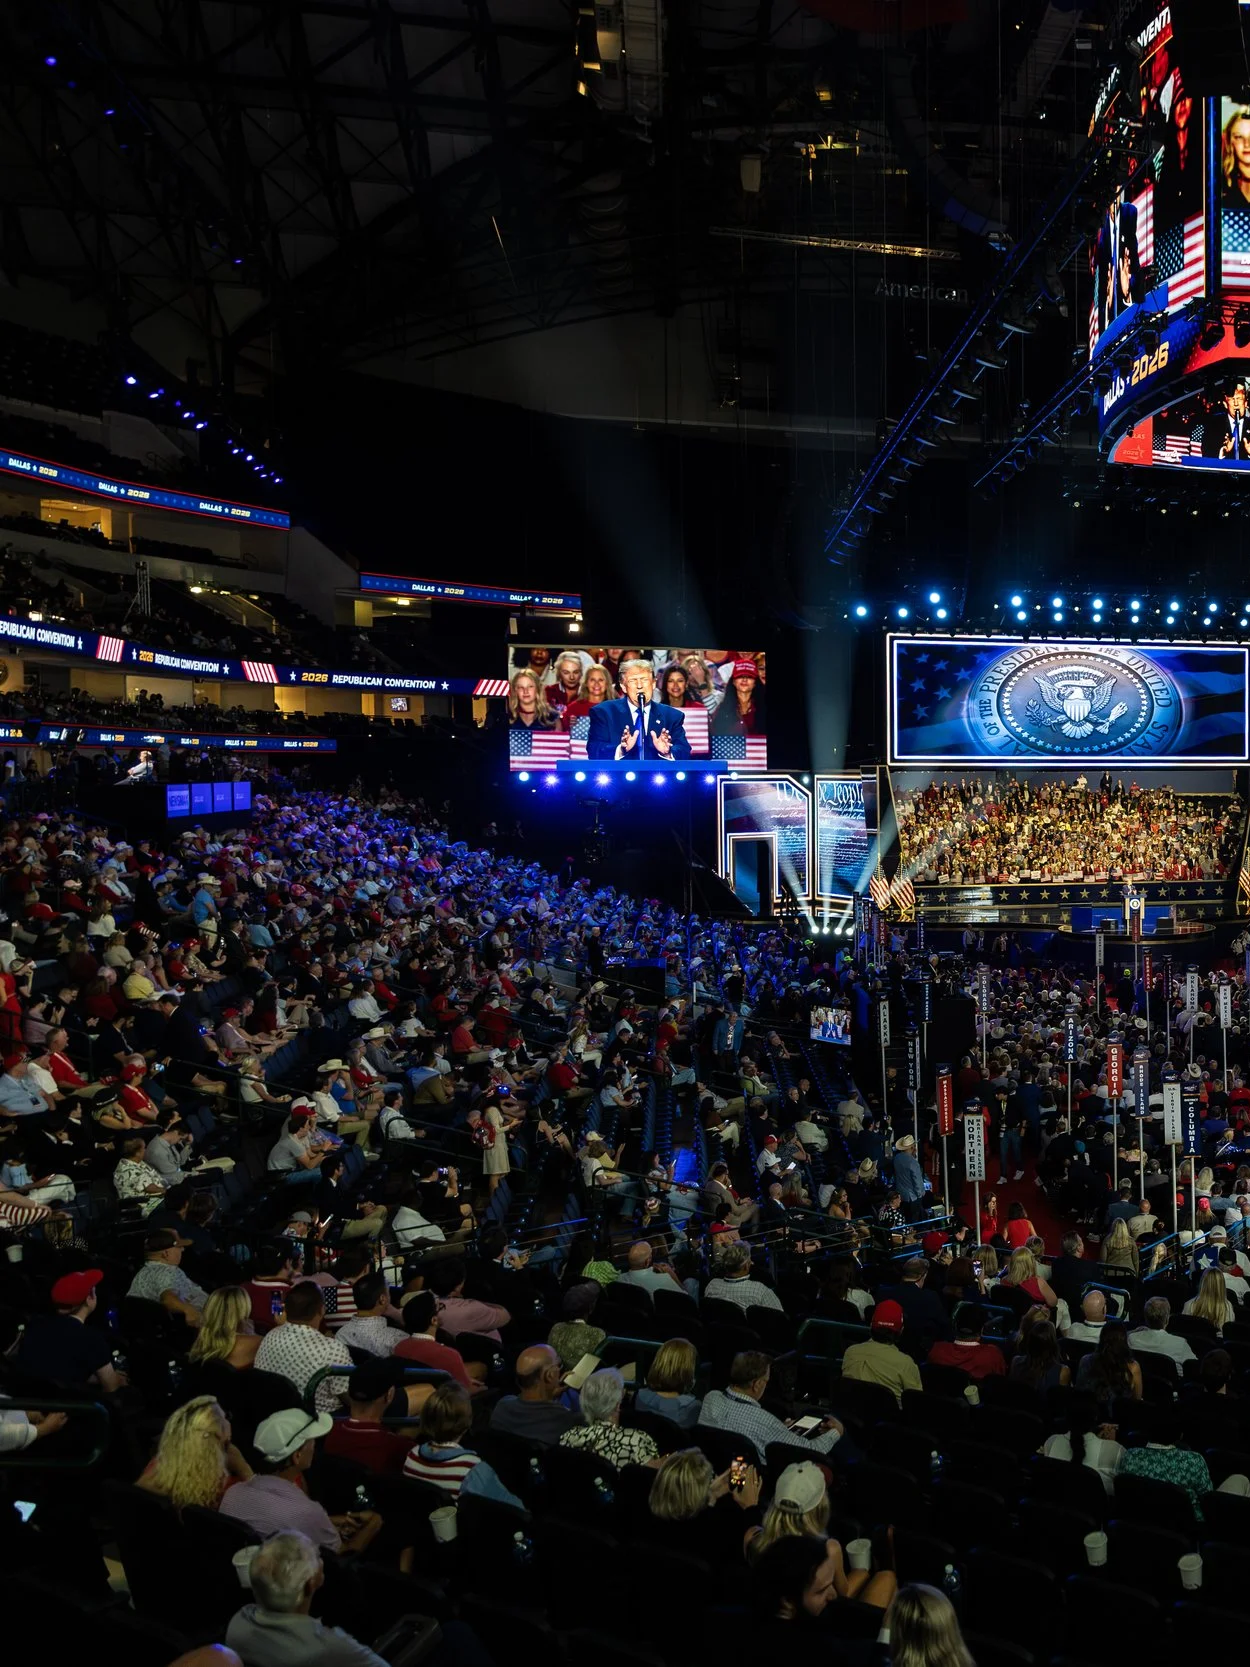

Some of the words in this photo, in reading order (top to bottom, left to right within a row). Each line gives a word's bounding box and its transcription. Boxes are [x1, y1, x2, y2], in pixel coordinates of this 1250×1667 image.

[874, 277, 968, 304] American
[1103, 376, 1125, 416] DALLAS
[1131, 341, 1169, 387] 2026
[8, 458, 31, 471] DALLAS
[98, 482, 118, 494] DALLAS
[200, 502, 222, 513] DALLAS
[412, 584, 435, 593] DALLAS
[0, 620, 36, 641] EPUBLICAN
[36, 628, 76, 648] CONVENTION
[139, 650, 154, 663] 2026
[155, 654, 180, 669] REPUBLICAN
[181, 658, 220, 673] CONVENTION
[302, 672, 328, 683] 2026
[332, 674, 383, 687] REPUBLICAN
[384, 677, 436, 689] CONVENTION
[1126, 656, 1172, 708] UNITED
[978, 698, 992, 719] THE
[983, 720, 1000, 736] OF
[968, 1119, 976, 1178] NORTHERN
